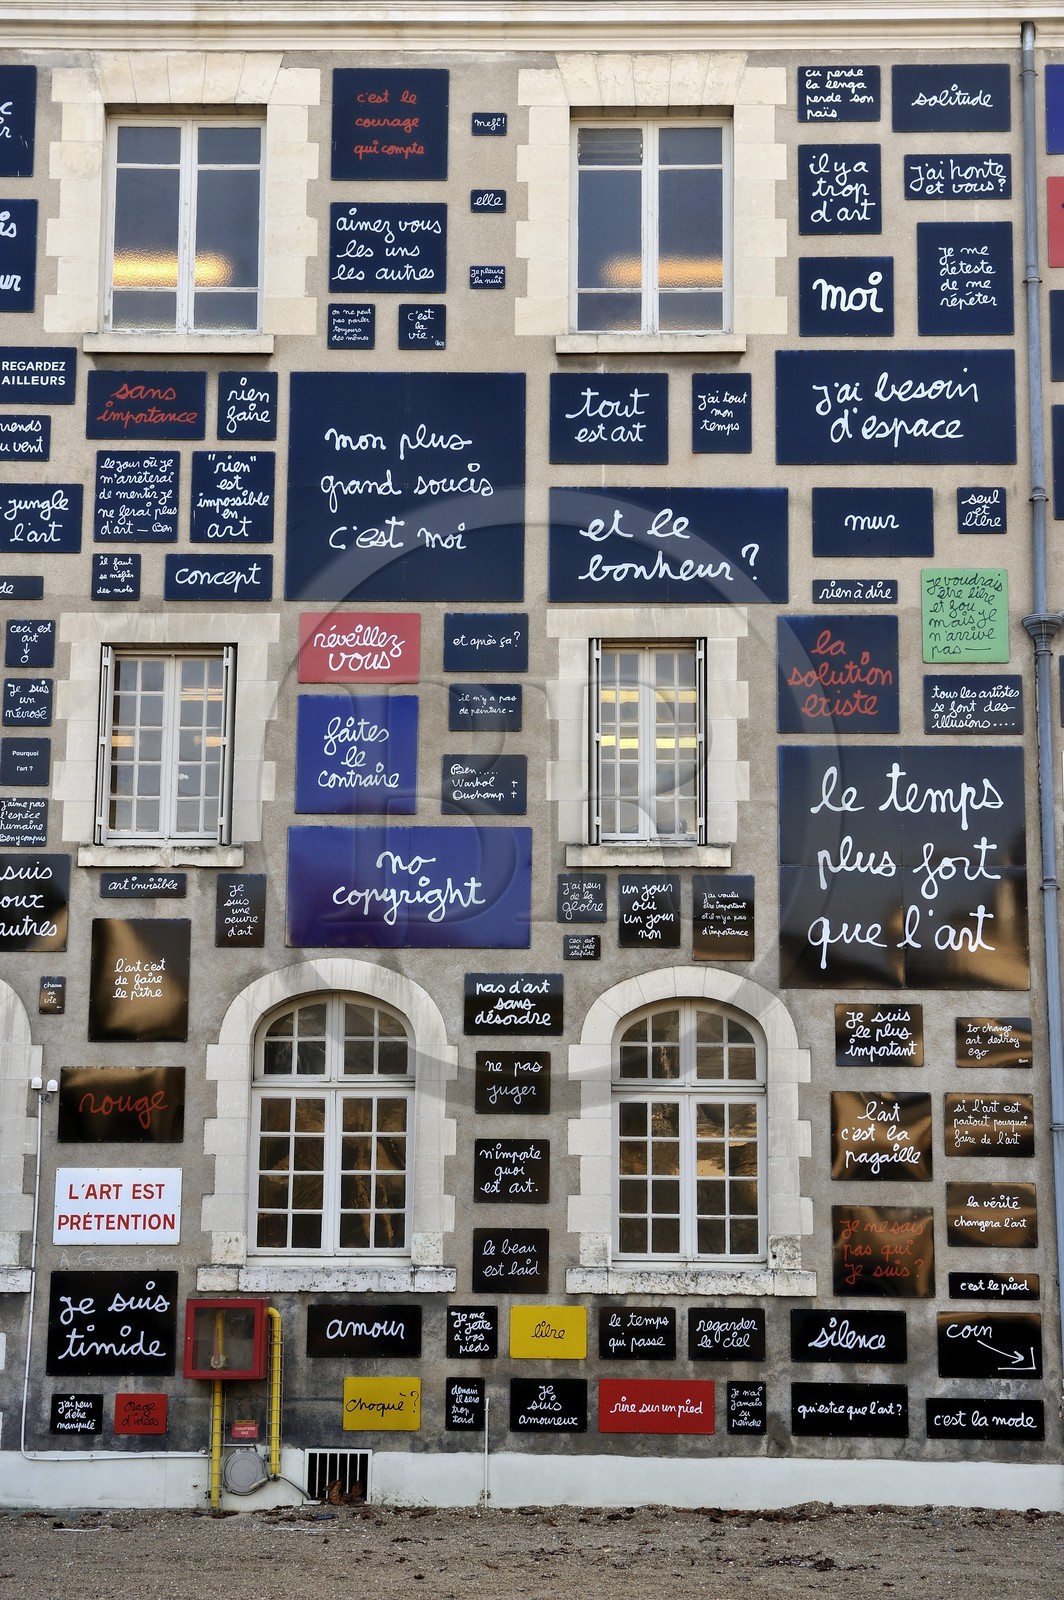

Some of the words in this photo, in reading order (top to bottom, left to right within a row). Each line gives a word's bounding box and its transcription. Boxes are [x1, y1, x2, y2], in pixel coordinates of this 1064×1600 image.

[827, 68, 864, 78] perde
[806, 79, 820, 89] la
[357, 90, 389, 103] c'est
[400, 91, 416, 104] le
[806, 94, 842, 104] perde
[850, 94, 874, 103] son
[911, 84, 993, 107] solitude
[355, 117, 419, 133] courage
[354, 140, 379, 160] qui
[382, 142, 424, 159] compte
[474, 193, 503, 206] elle
[811, 177, 870, 204] trop
[811, 198, 876, 222] d'art
[336, 208, 395, 243] aimez
[399, 220, 442, 234] vous
[337, 240, 374, 257] les
[386, 245, 420, 256] uns
[960, 246, 990, 256] me
[332, 264, 365, 280] les
[375, 264, 435, 280] autres
[939, 261, 996, 276] déteste
[812, 271, 884, 313] moi
[940, 280, 957, 291] de
[966, 280, 992, 289] me
[940, 292, 998, 310] répéter
[2, 361, 66, 371] REGARDEZ
[1, 376, 66, 386] AILLEURS
[227, 377, 270, 403] rien
[875, 367, 979, 402] besoin
[111, 383, 176, 401] sans
[565, 388, 650, 419] tout
[96, 400, 199, 428] importance
[227, 403, 271, 433] faire
[575, 423, 607, 442] est
[611, 423, 646, 442] art
[830, 407, 964, 448] d'espace
[325, 428, 386, 450] mon
[399, 424, 472, 460] plus
[217, 475, 243, 491] est
[321, 470, 402, 513] grand
[413, 463, 494, 496] soucis
[197, 489, 270, 513] impossible
[221, 508, 238, 519] en
[845, 514, 899, 531] mur
[10, 521, 63, 542] l'art
[207, 517, 252, 538] art
[329, 516, 405, 549] c'est
[417, 522, 466, 549] moi
[579, 510, 633, 541] et
[647, 508, 690, 538] le
[578, 550, 734, 581] bonheur
[175, 563, 261, 593] concept
[819, 581, 852, 599] rien
[855, 582, 865, 599] à
[866, 581, 892, 599] dire
[10, 622, 31, 633] ceci
[37, 623, 51, 633] est
[22, 634, 38, 642] art
[314, 624, 405, 657] réveillez
[453, 635, 468, 645] et
[470, 635, 496, 650] après
[811, 630, 846, 655] la
[329, 651, 391, 671] vous
[787, 652, 893, 686] solution
[931, 686, 957, 699] tous
[961, 686, 977, 698] les
[978, 685, 1019, 698] artistes
[801, 690, 878, 718] existe
[931, 703, 946, 712] se
[950, 700, 977, 718] font
[984, 701, 1016, 712] des
[341, 746, 367, 767] le
[318, 762, 399, 788] contraire
[810, 766, 865, 813] le
[879, 763, 1004, 830] temps
[376, 851, 436, 875] no
[818, 836, 897, 890] plus
[912, 836, 1001, 899] fort
[108, 878, 130, 890] art
[131, 876, 178, 891] invisible
[622, 885, 639, 894] un
[641, 884, 673, 901] jour
[333, 876, 486, 926] copyright
[632, 896, 657, 911] oui
[624, 913, 642, 924] un
[645, 913, 674, 930] jour
[638, 929, 661, 939] non
[808, 916, 888, 969] que
[897, 904, 996, 952] l'art
[114, 958, 140, 973] l'art
[144, 958, 166, 971] c'est
[115, 974, 128, 985] de
[134, 972, 162, 990] faire
[476, 982, 505, 995] pas
[509, 979, 551, 994] d'art
[113, 988, 128, 999] le
[494, 998, 536, 1010] sans
[475, 1010, 551, 1026] désordre
[871, 1009, 911, 1022] suis
[852, 1026, 871, 1038] le
[876, 1024, 912, 1041] plus
[846, 1039, 918, 1062] important
[79, 1090, 168, 1129] rouge
[857, 1101, 900, 1122] l'art
[841, 1124, 875, 1141] c'est
[887, 1126, 910, 1140] la
[480, 1143, 542, 1163] n'importe
[845, 1143, 921, 1174] pagaille
[494, 1161, 525, 1181] quoi
[68, 1184, 123, 1199] L'ART
[132, 1184, 165, 1199] EST
[480, 1180, 500, 1193] est
[967, 1196, 979, 1207] la
[984, 1195, 1021, 1209] vérité
[57, 1212, 175, 1230] PRÉTENTION
[954, 1216, 1001, 1232] changera
[1004, 1216, 1027, 1228] l'art
[108, 1280, 170, 1312] suis
[326, 1319, 405, 1339] amour
[531, 1320, 566, 1339] libre
[696, 1317, 758, 1343] regarder
[808, 1317, 886, 1349] silence
[946, 1323, 992, 1338] coin
[58, 1325, 166, 1360] timide
[697, 1334, 713, 1348] le
[722, 1332, 750, 1348] ciel
[610, 1396, 636, 1413] rire
[639, 1404, 660, 1413] sur
[661, 1404, 676, 1413] un
[678, 1399, 703, 1417] pied
[934, 1413, 966, 1426] c'est
[971, 1410, 989, 1426] la
[992, 1412, 1037, 1428] mode
